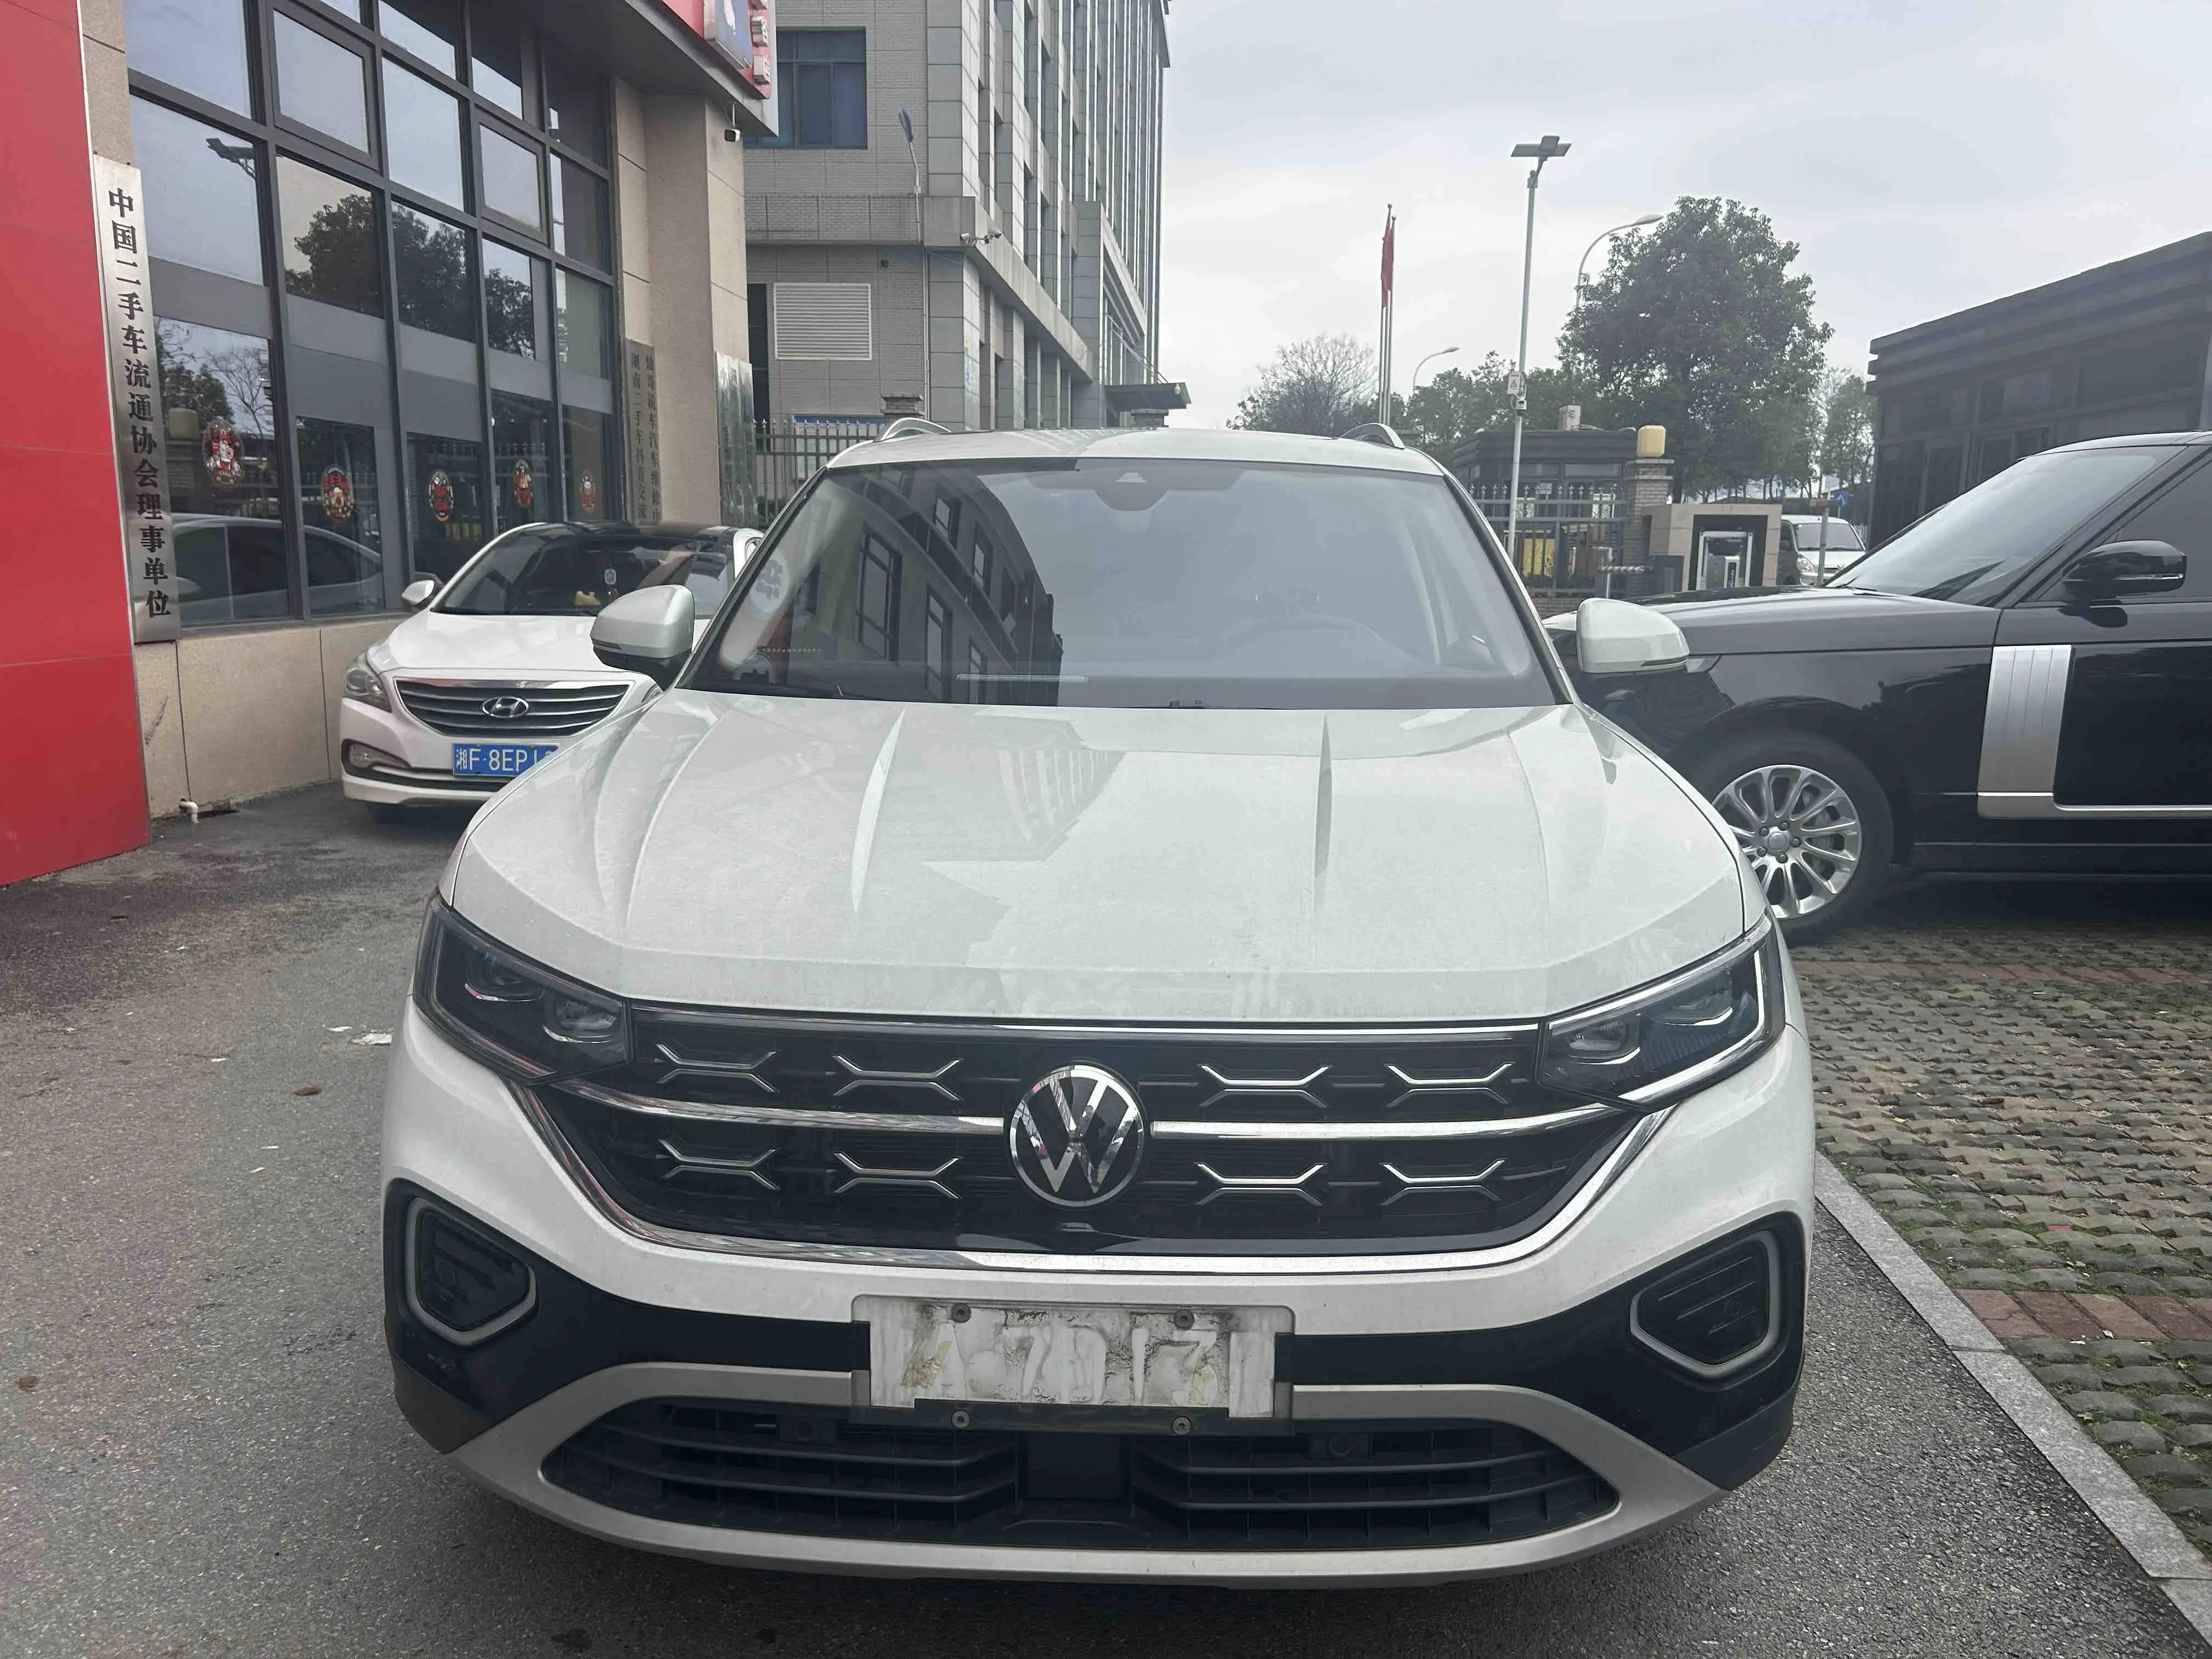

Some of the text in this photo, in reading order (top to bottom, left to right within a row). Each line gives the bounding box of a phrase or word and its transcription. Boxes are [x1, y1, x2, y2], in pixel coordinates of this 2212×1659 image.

[108, 188, 171, 618] 中国二手车流通协会理事单位
